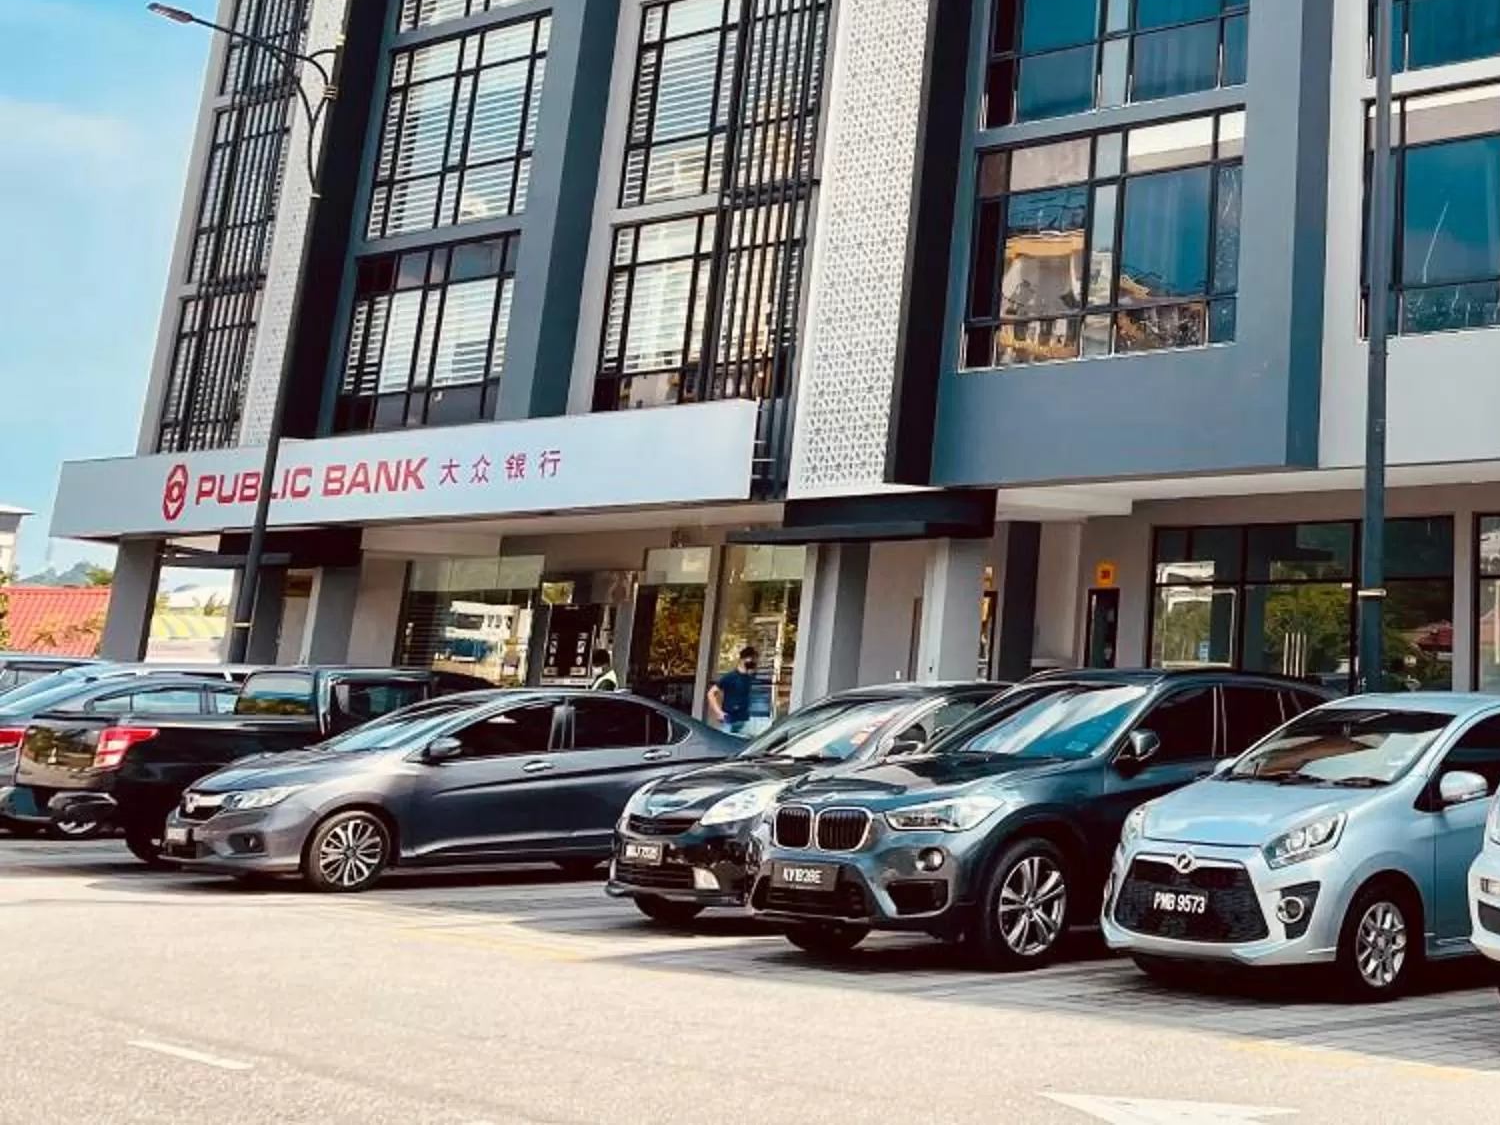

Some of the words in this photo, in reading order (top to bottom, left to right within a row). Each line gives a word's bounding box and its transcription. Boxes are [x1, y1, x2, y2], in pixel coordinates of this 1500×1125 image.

[321, 457, 429, 496] BANK
[438, 450, 562, 485] 大众银行
[1177, 894, 1205, 914] 9573
